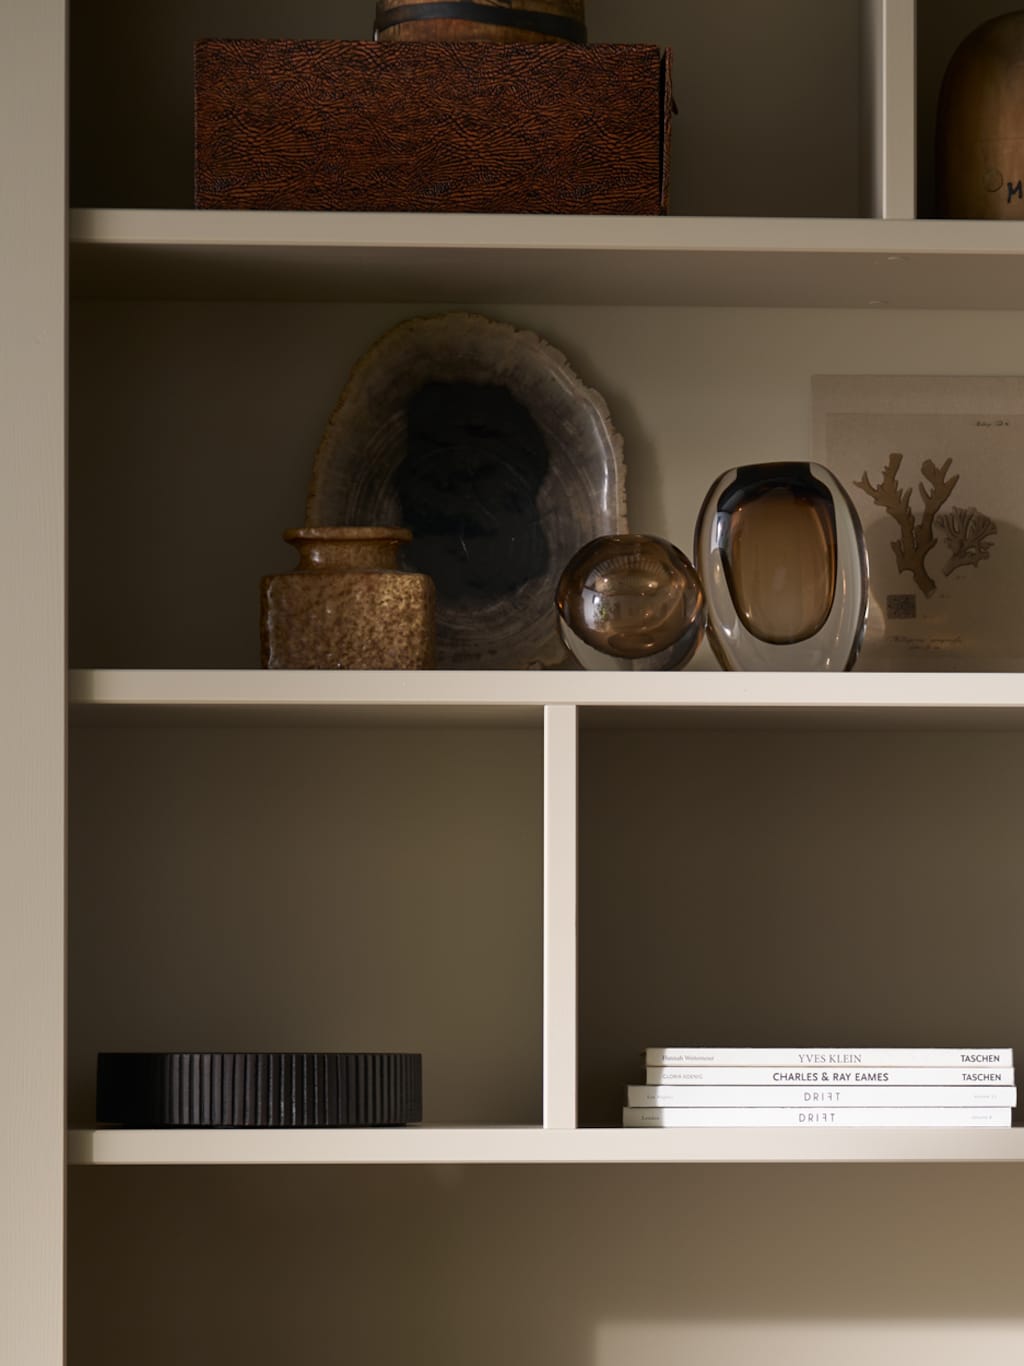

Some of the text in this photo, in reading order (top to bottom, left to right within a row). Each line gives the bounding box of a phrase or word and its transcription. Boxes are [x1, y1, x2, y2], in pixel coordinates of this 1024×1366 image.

[798, 1054, 863, 1064] YVES KLEIN
[960, 1054, 1001, 1063] TASCHEN
[772, 1072, 889, 1082] CHARLES & RAY EAMES
[961, 1073, 1002, 1082] TASCHEN
[803, 1092, 841, 1102] DRIFT
[798, 1113, 836, 1123] DRIFT
